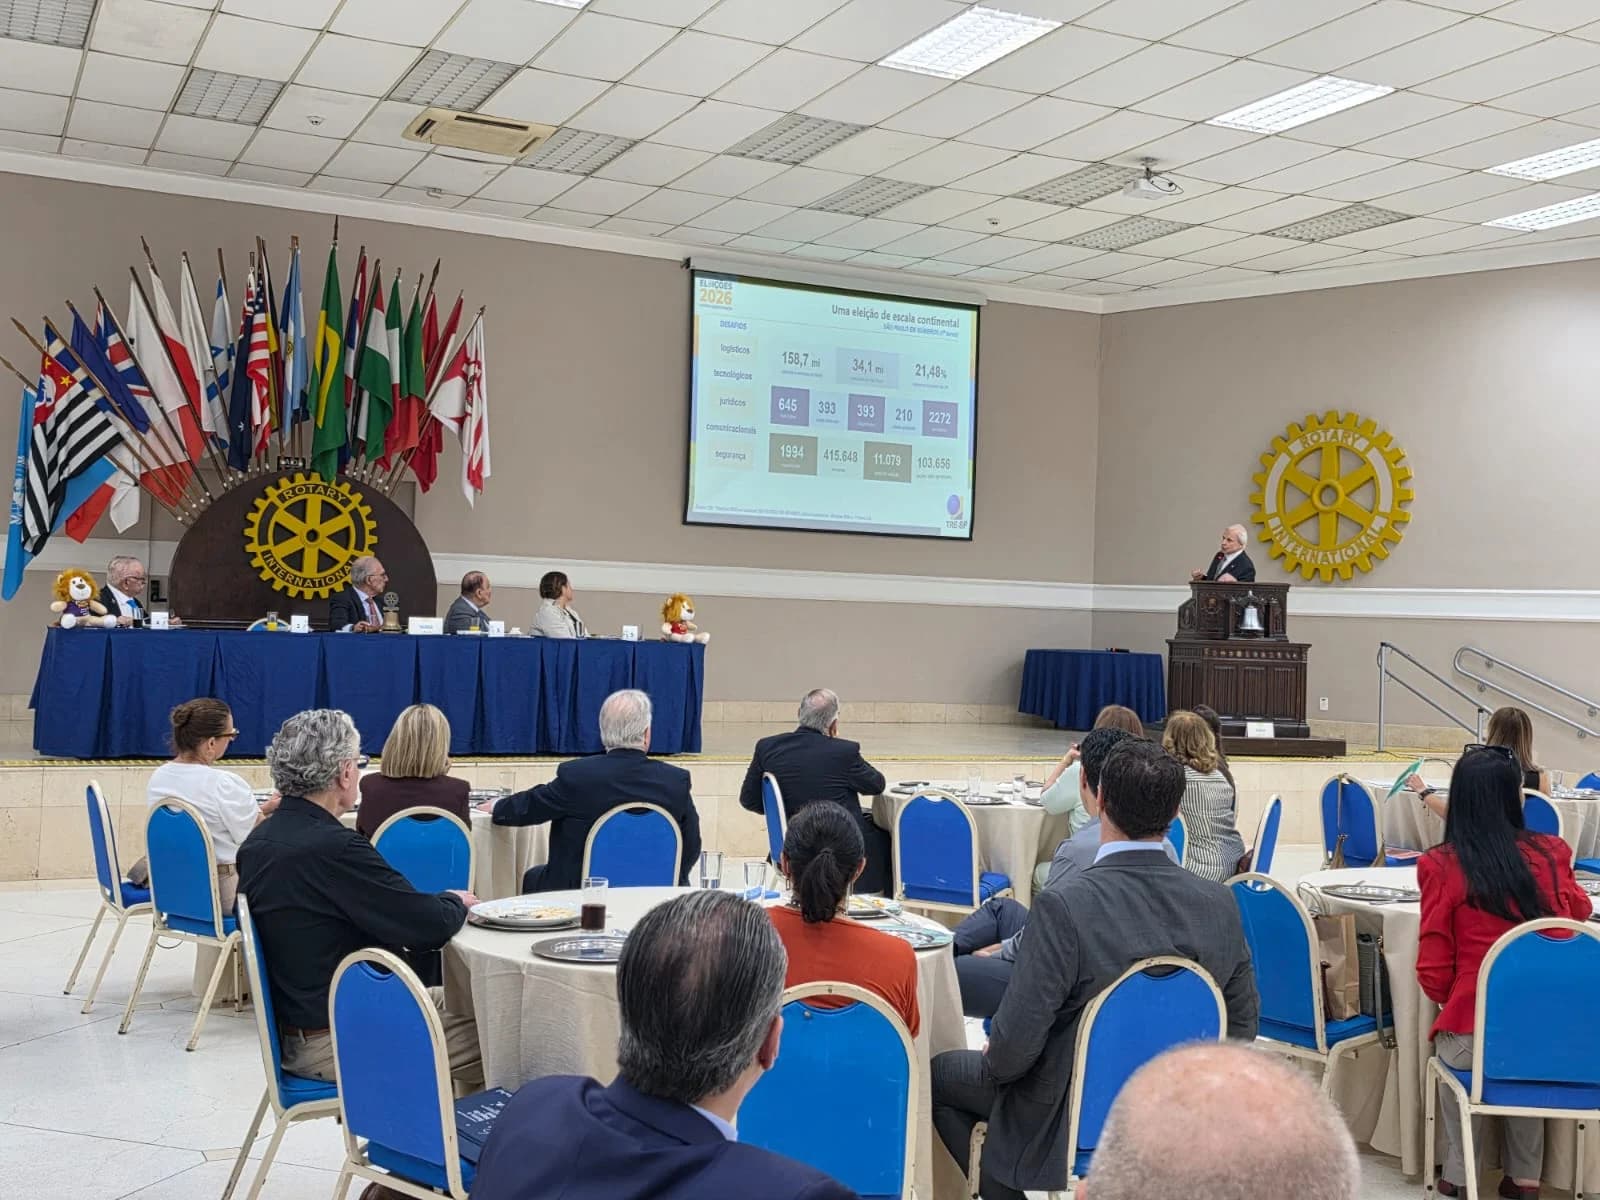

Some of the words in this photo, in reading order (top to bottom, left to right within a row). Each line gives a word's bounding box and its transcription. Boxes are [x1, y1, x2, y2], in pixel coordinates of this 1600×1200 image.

[700, 288, 733, 305] 2026
[832, 304, 850, 316] Uma
[852, 307, 879, 320] eleição
[881, 310, 891, 320] de
[892, 313, 916, 323] escala
[917, 316, 960, 328] continental
[782, 351, 809, 368] 158,7
[852, 358, 873, 374] 34,1
[713, 369, 753, 381] tecnológicos
[778, 398, 798, 412] 645
[818, 401, 836, 415] 393
[857, 404, 875, 418] 393
[895, 408, 913, 422] 210
[928, 411, 952, 425] 2272
[1299, 429, 1361, 448] ROTARY
[780, 444, 804, 459] 1994
[917, 456, 951, 470] 103.656
[283, 484, 347, 502] ROTARY
[1269, 525, 1384, 565] INTERNATIONAL
